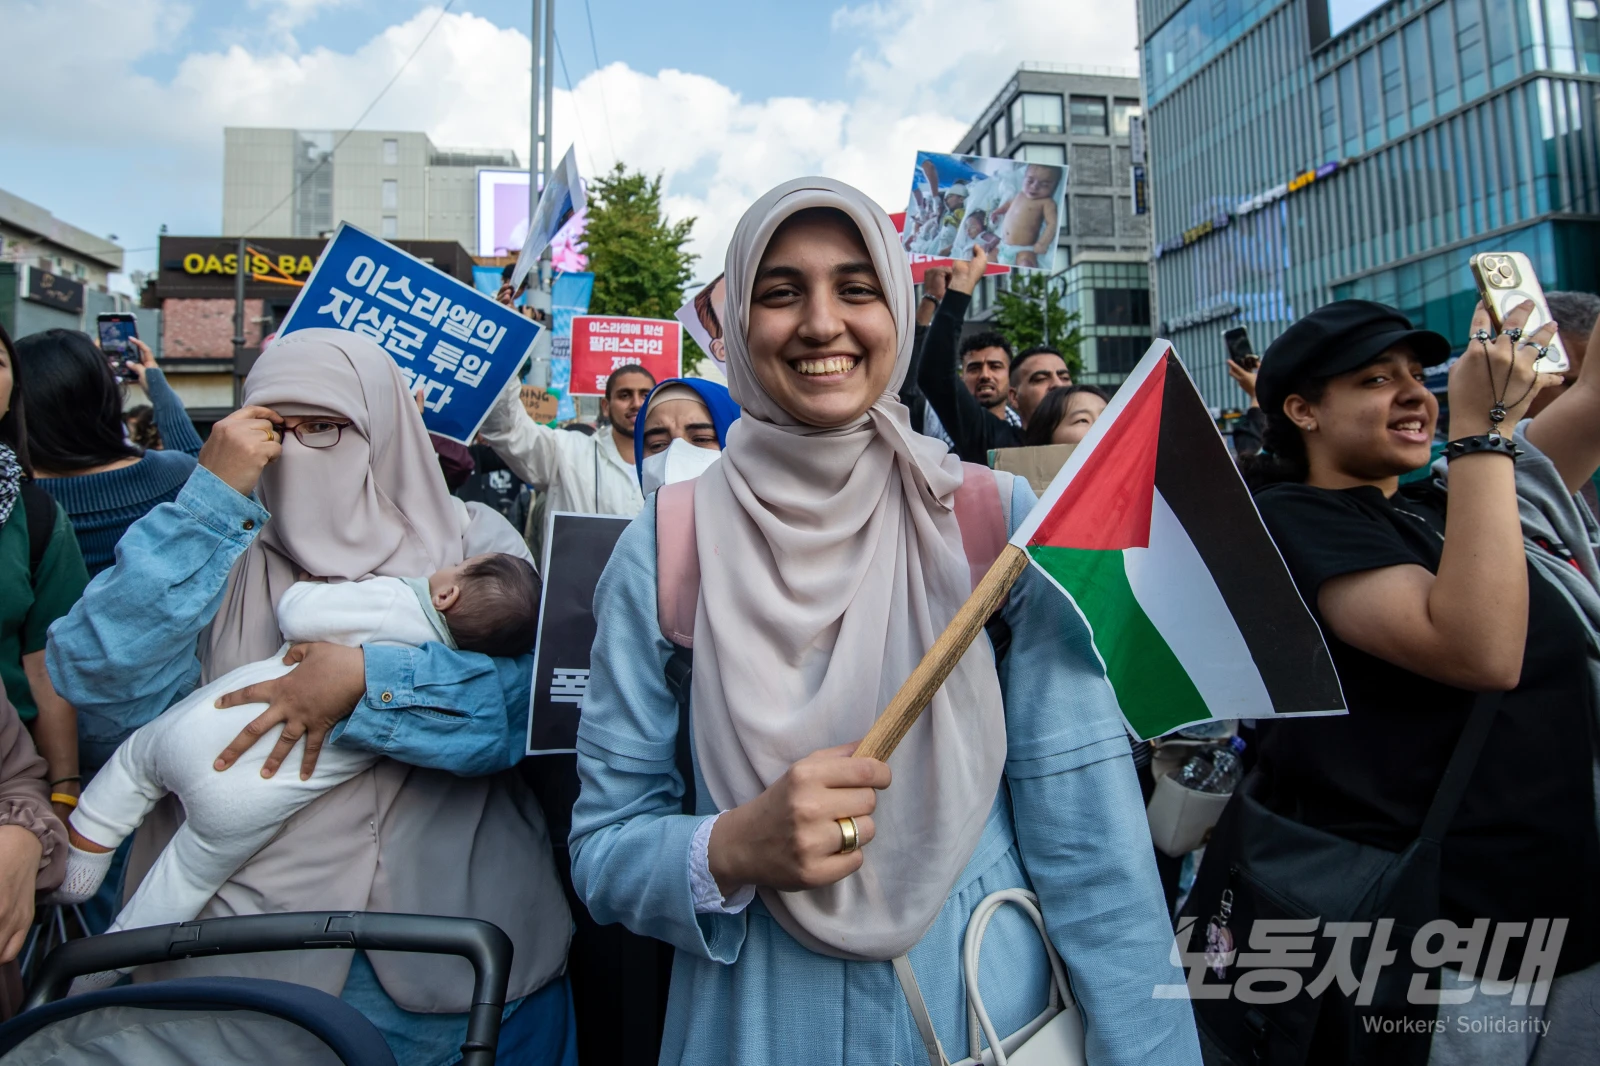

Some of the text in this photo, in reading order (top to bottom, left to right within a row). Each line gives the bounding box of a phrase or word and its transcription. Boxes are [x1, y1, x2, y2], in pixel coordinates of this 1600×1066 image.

[183, 253, 320, 275] OASIS BA
[346, 255, 507, 354] 이스라엘의
[317, 287, 491, 388] 지상군 투입
[589, 321, 641, 335] 이스라엘에
[589, 336, 663, 355] 팔레스타인
